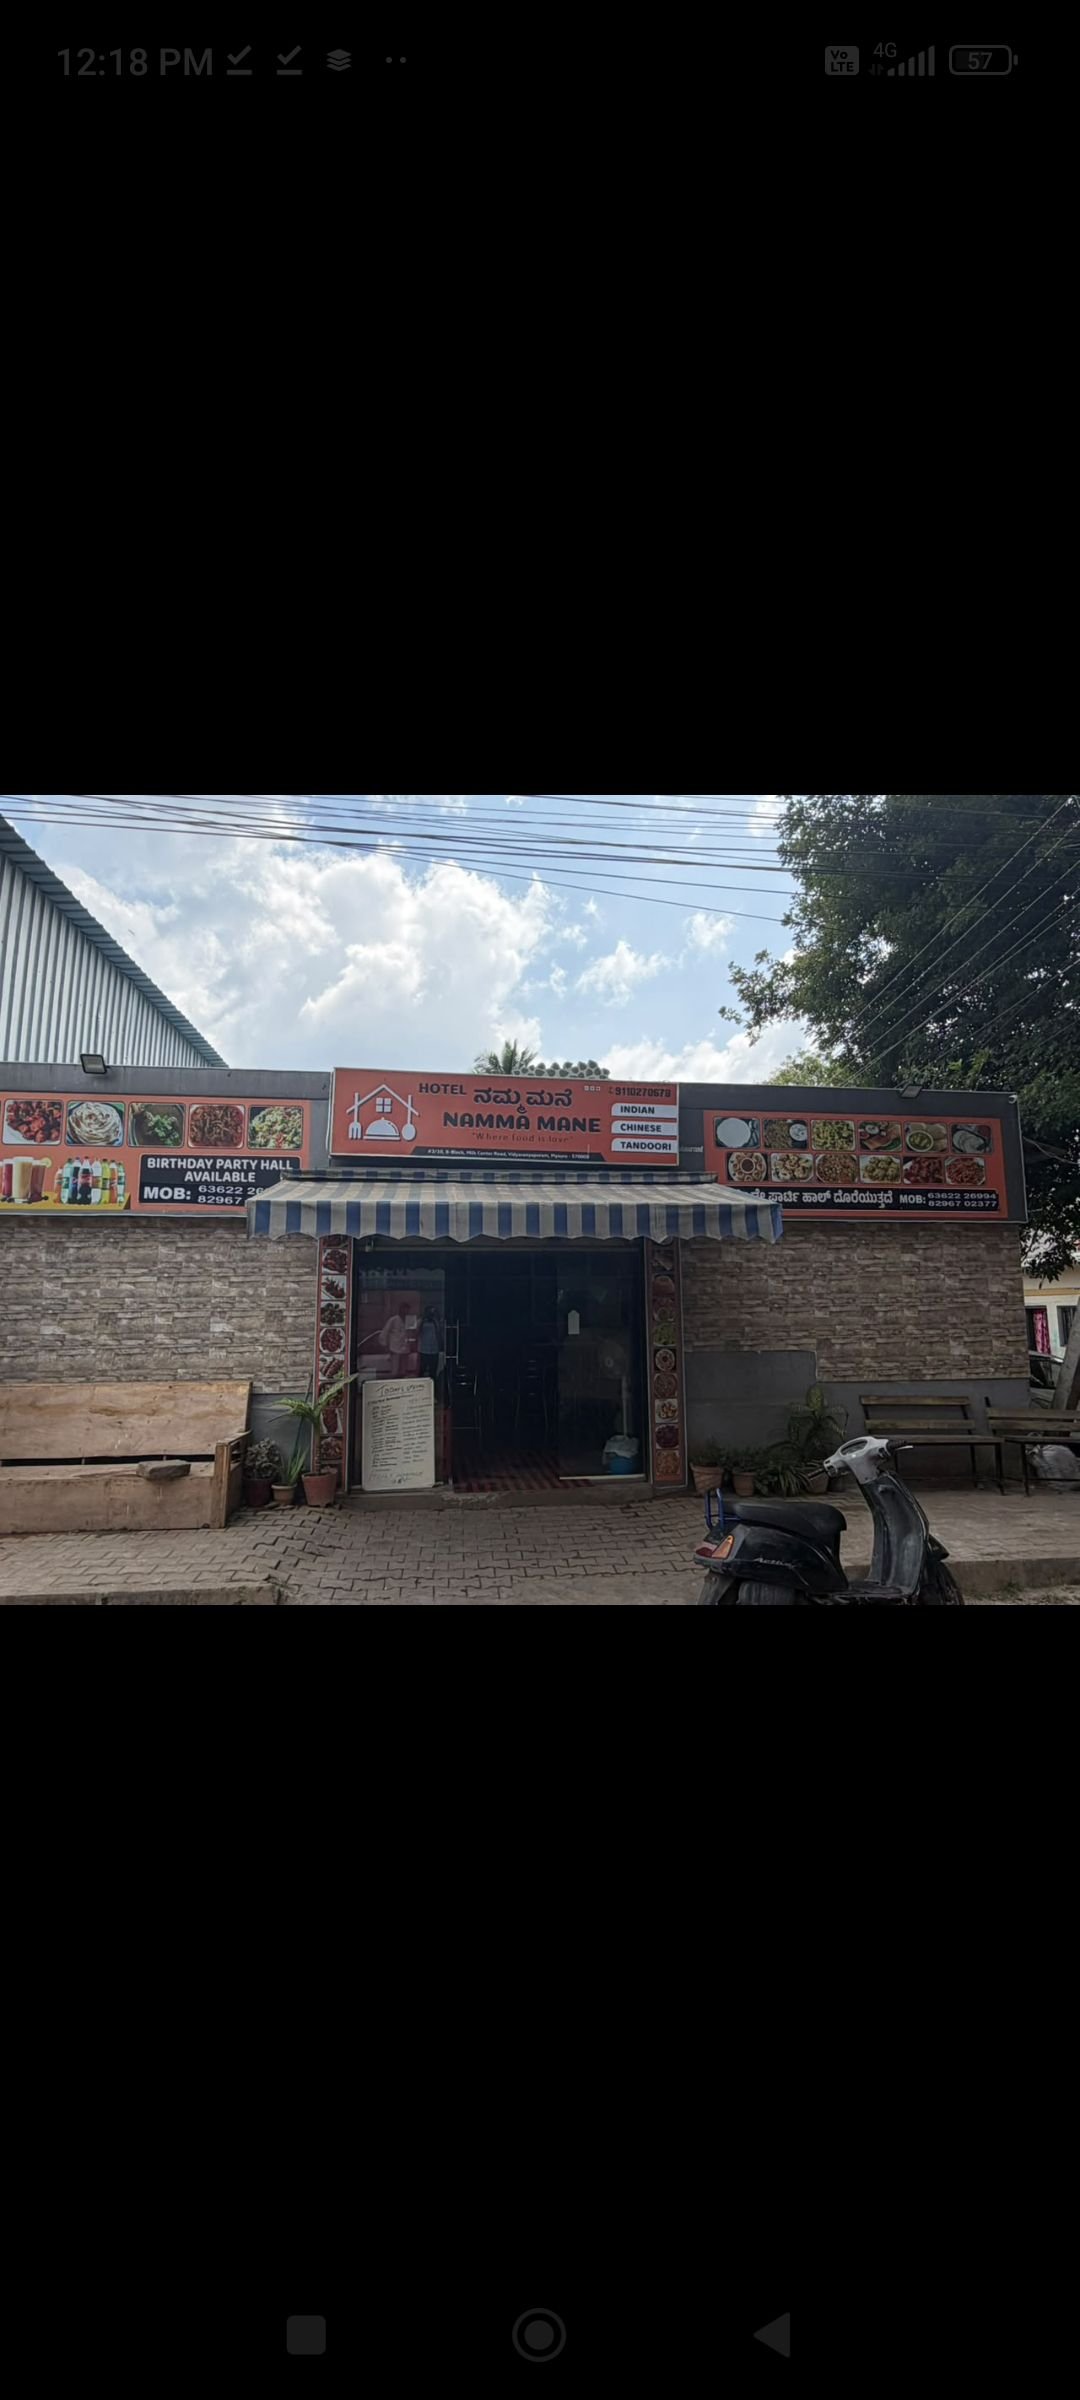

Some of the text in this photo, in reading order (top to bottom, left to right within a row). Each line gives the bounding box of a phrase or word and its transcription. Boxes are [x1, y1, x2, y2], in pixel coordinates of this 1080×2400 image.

[419, 1082, 467, 1095] HOTEL
[473, 1087, 572, 1114] ನಮ್ಮ ಮನೆ
[620, 1105, 655, 1114] INDIAN
[443, 1112, 601, 1132] NAMMA MANE
[620, 1123, 662, 1132] CHINESE
[512, 1133, 535, 1142] food
[538, 1134, 546, 1143] is
[620, 1141, 672, 1151] TANDOORI
[147, 1157, 293, 1170] BIRTHDAY PARTY HALL
[184, 1171, 256, 1183] AVAILABLE
[143, 1186, 192, 1201] MOB:
[198, 1185, 243, 1195] 63622
[197, 1195, 243, 1205] 82967
[899, 1194, 926, 1204] MOB:
